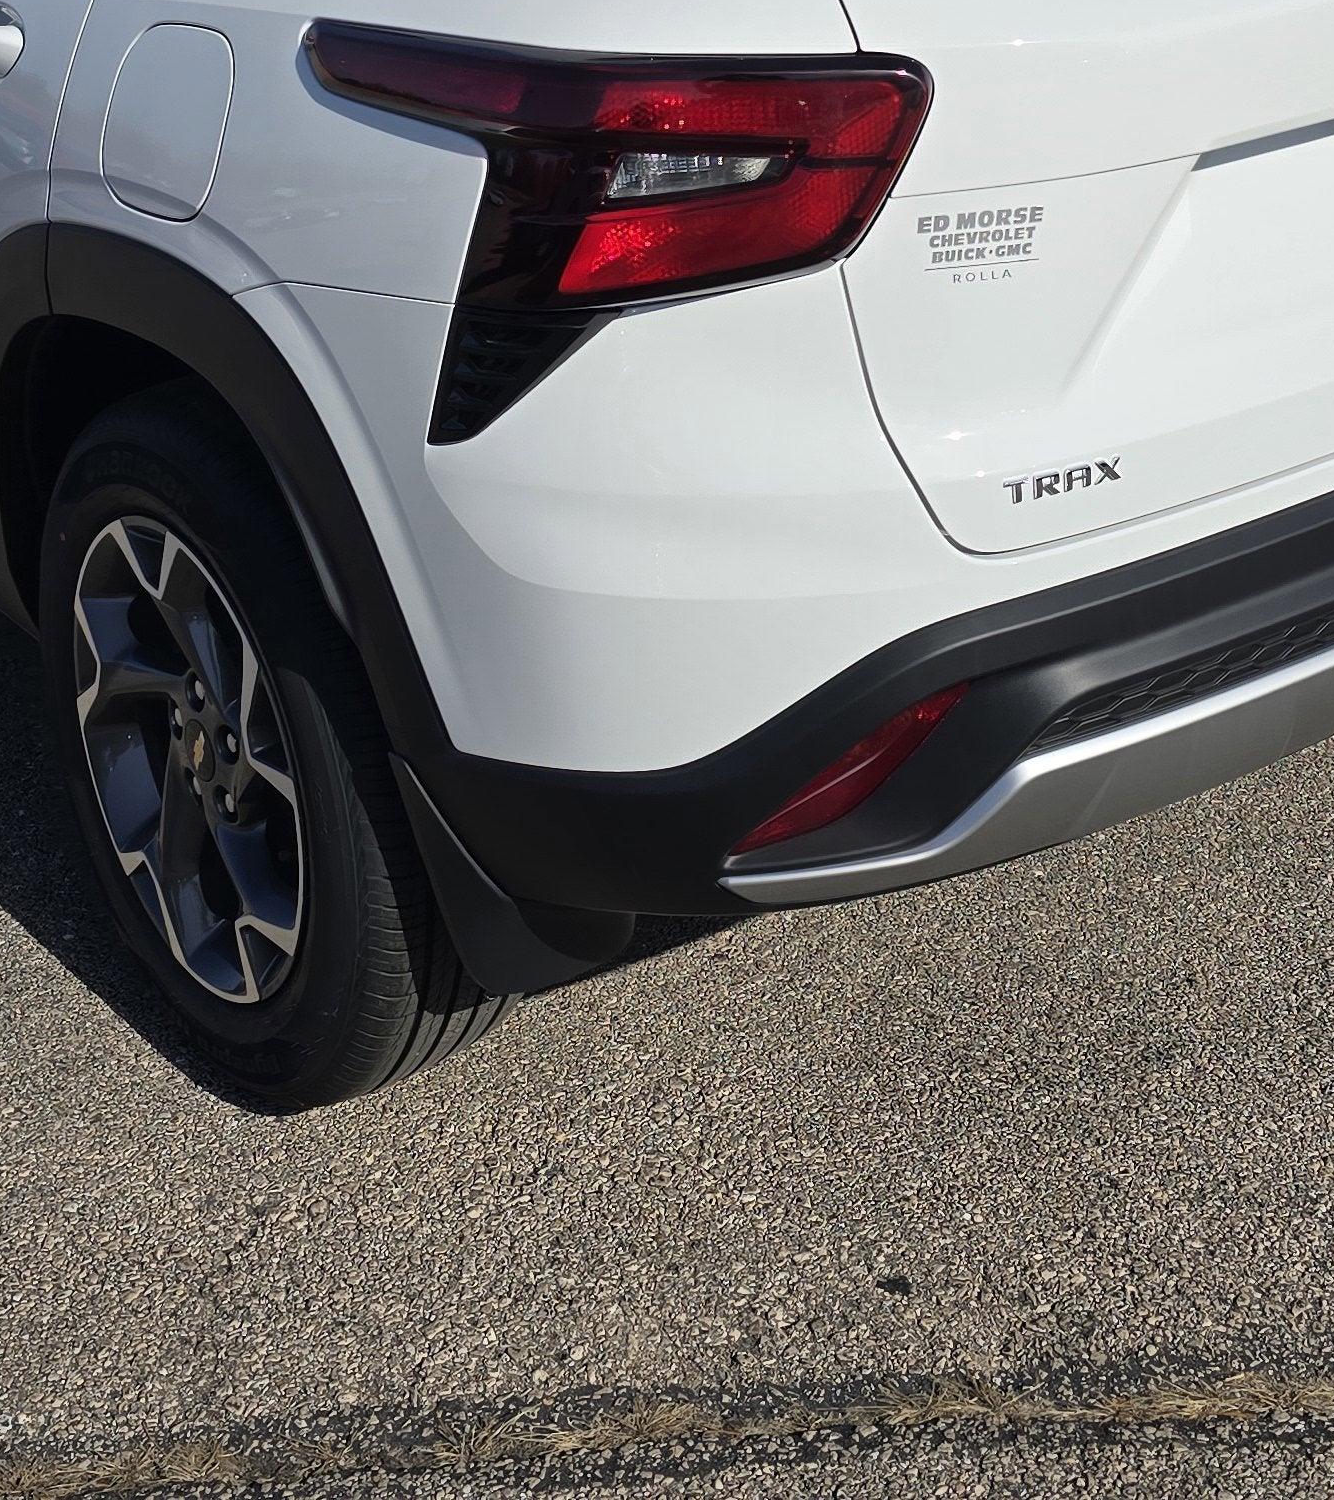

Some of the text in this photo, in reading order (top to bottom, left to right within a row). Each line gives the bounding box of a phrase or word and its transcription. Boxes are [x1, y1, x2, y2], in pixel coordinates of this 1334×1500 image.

[917, 206, 1044, 234] ED MORSE
[929, 226, 1036, 248] CHEVROLET
[953, 269, 1012, 283] ROLLA
[1003, 454, 1122, 504] TRAX
